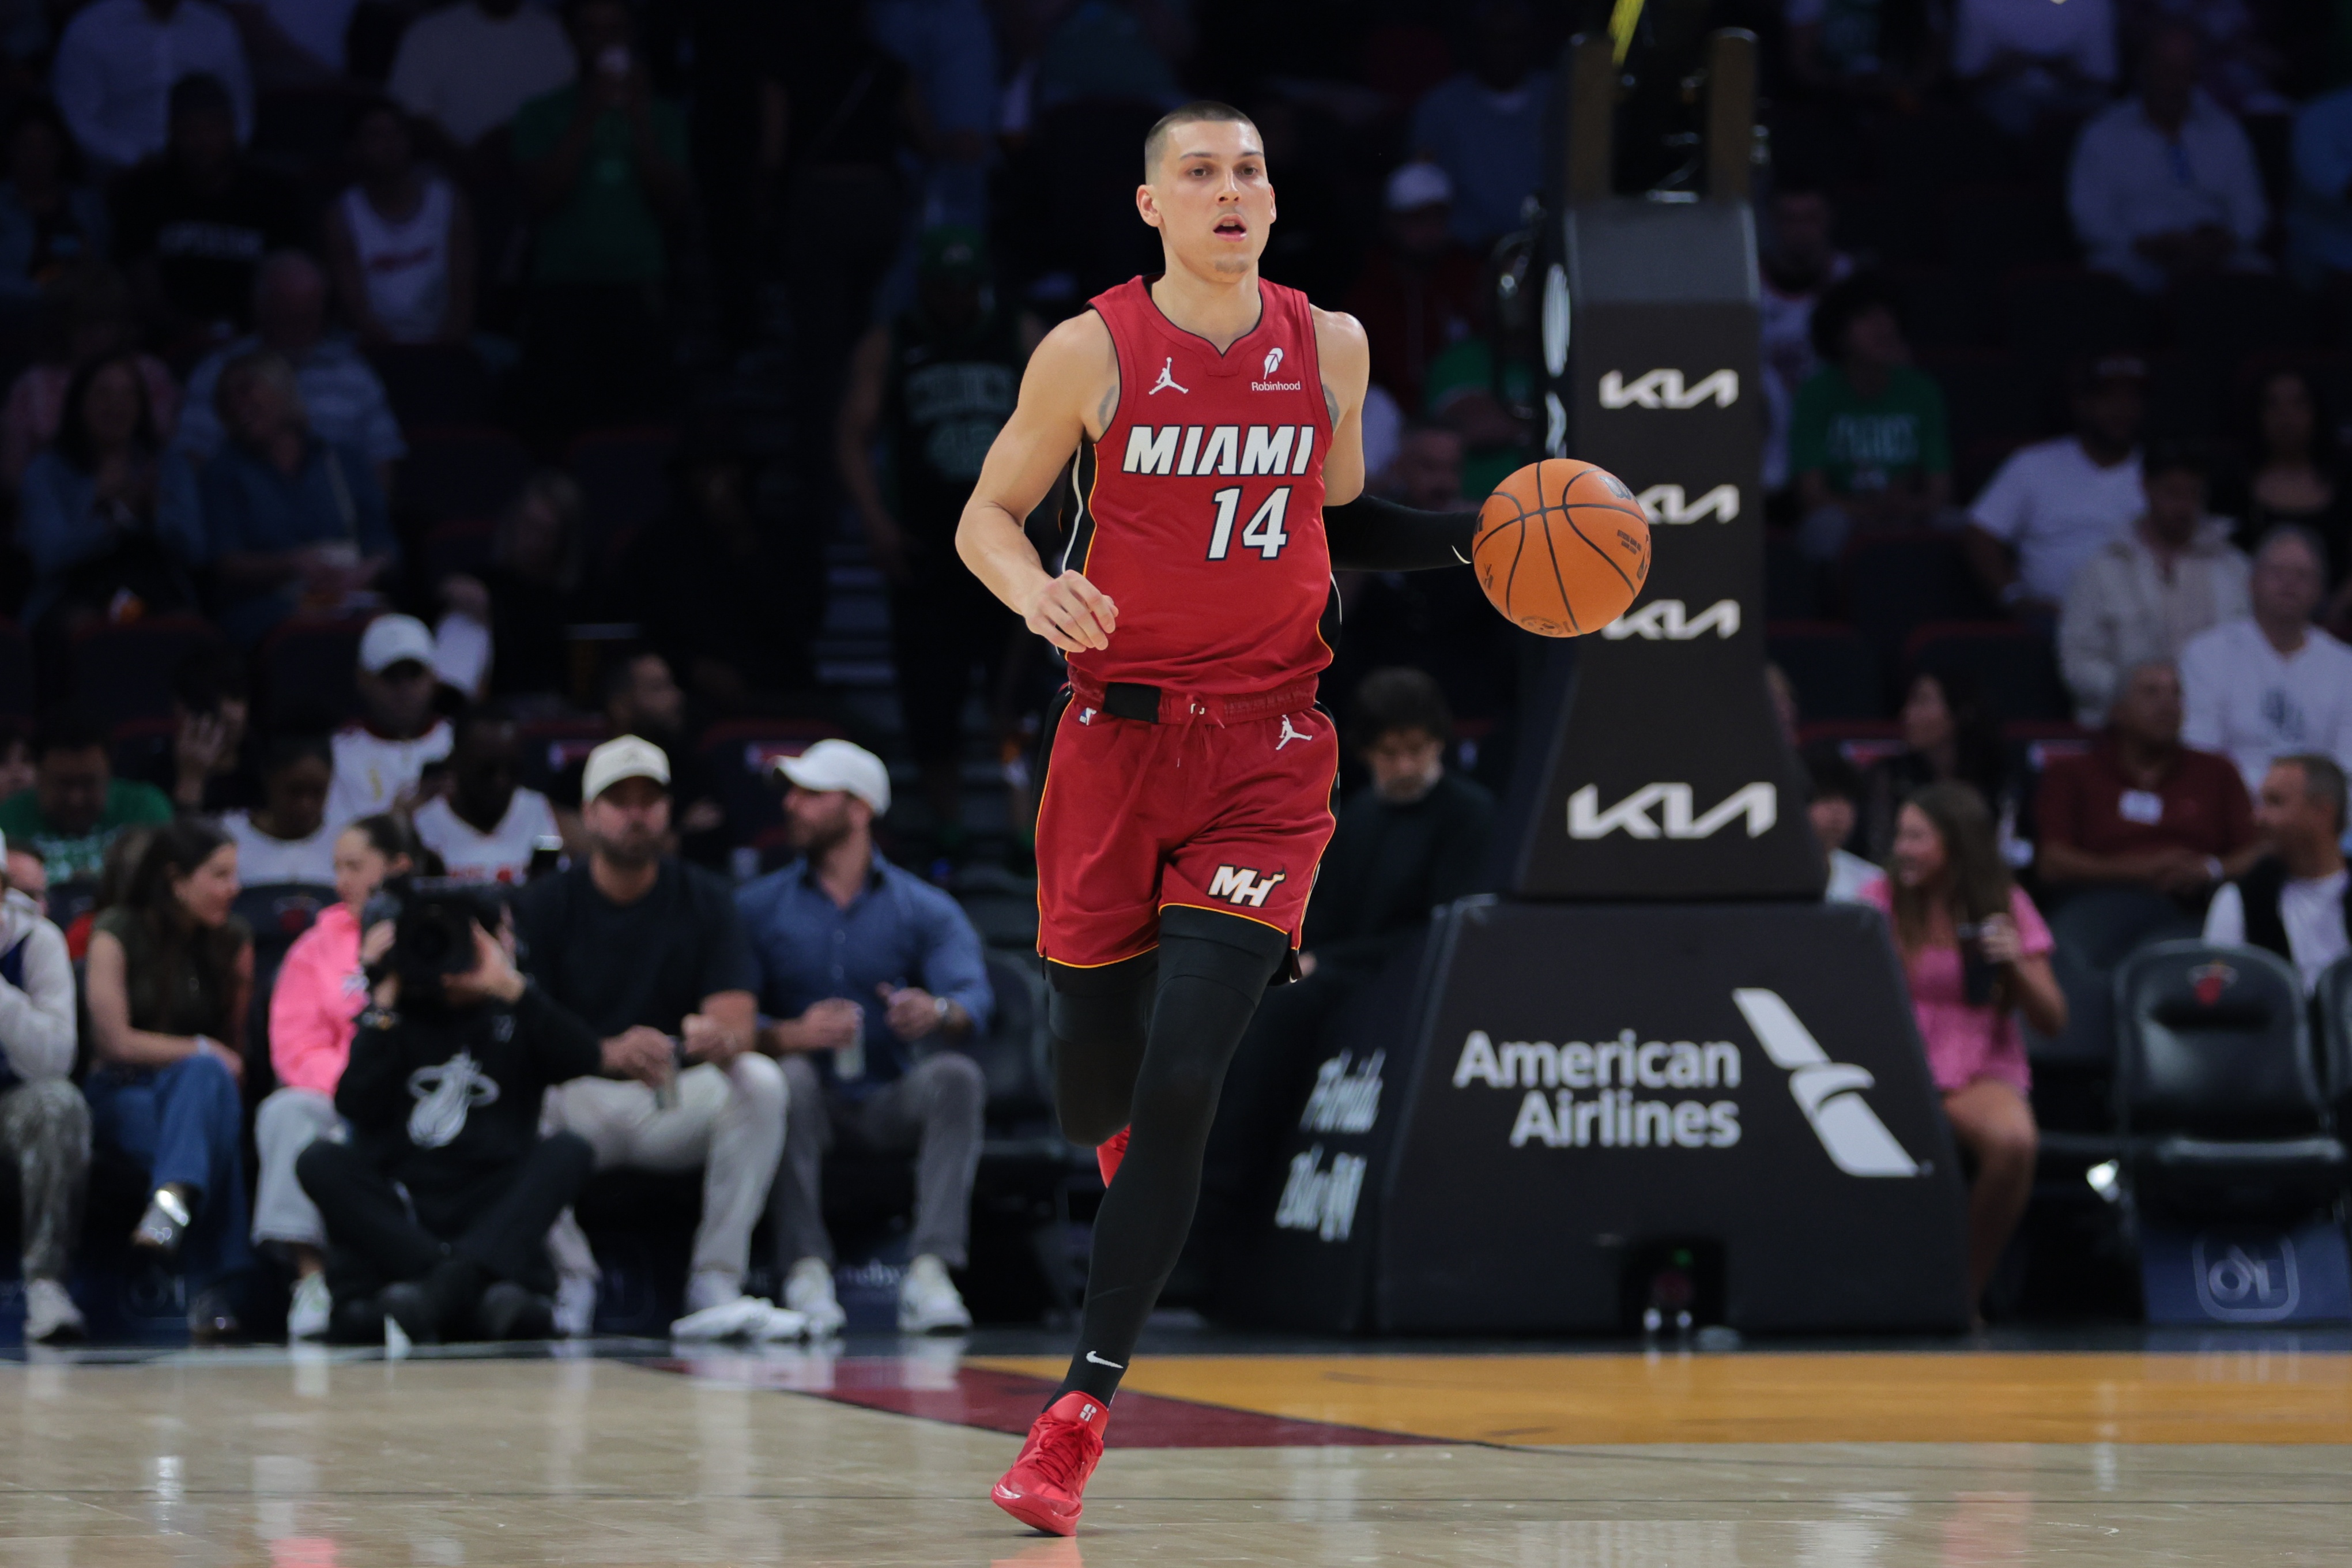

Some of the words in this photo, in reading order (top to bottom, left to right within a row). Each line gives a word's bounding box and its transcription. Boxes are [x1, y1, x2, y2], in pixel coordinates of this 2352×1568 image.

[1252, 380, 1301, 392] Robinhood
[1599, 368, 1739, 409] KIA
[1122, 425, 1314, 476] MIAMI
[1206, 486, 1293, 560] 14
[1567, 782, 1777, 839] KIA
[1453, 1029, 1741, 1089] American
[1510, 1088, 1741, 1148] Airlines
